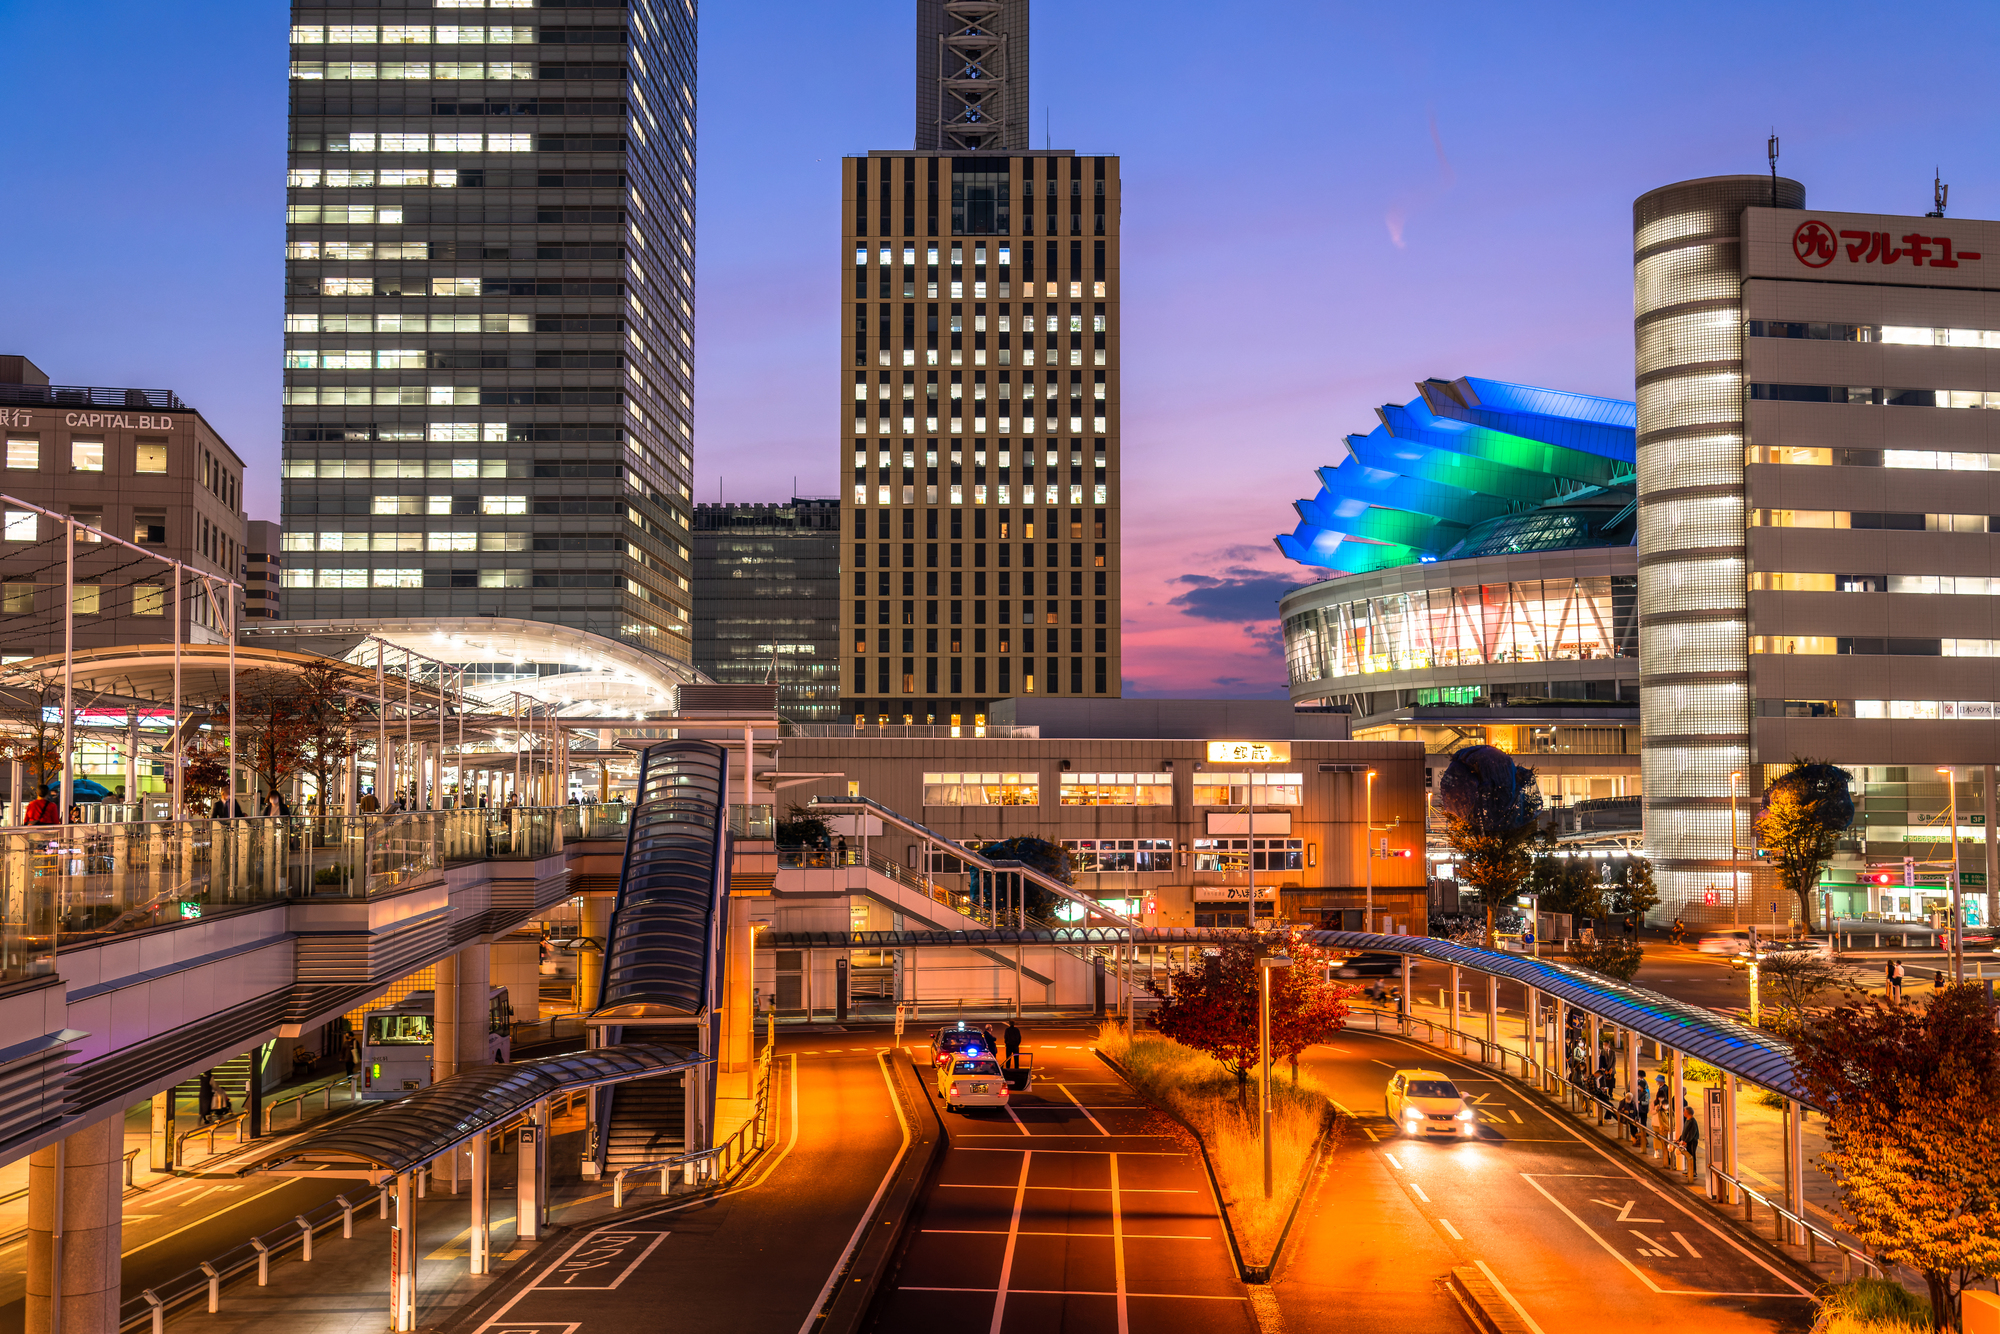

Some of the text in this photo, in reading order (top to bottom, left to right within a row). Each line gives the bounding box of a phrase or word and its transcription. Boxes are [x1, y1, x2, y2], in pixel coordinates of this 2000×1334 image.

[1840, 230, 1981, 268] マルキュー
[558, 1236, 638, 1285] タクシー
